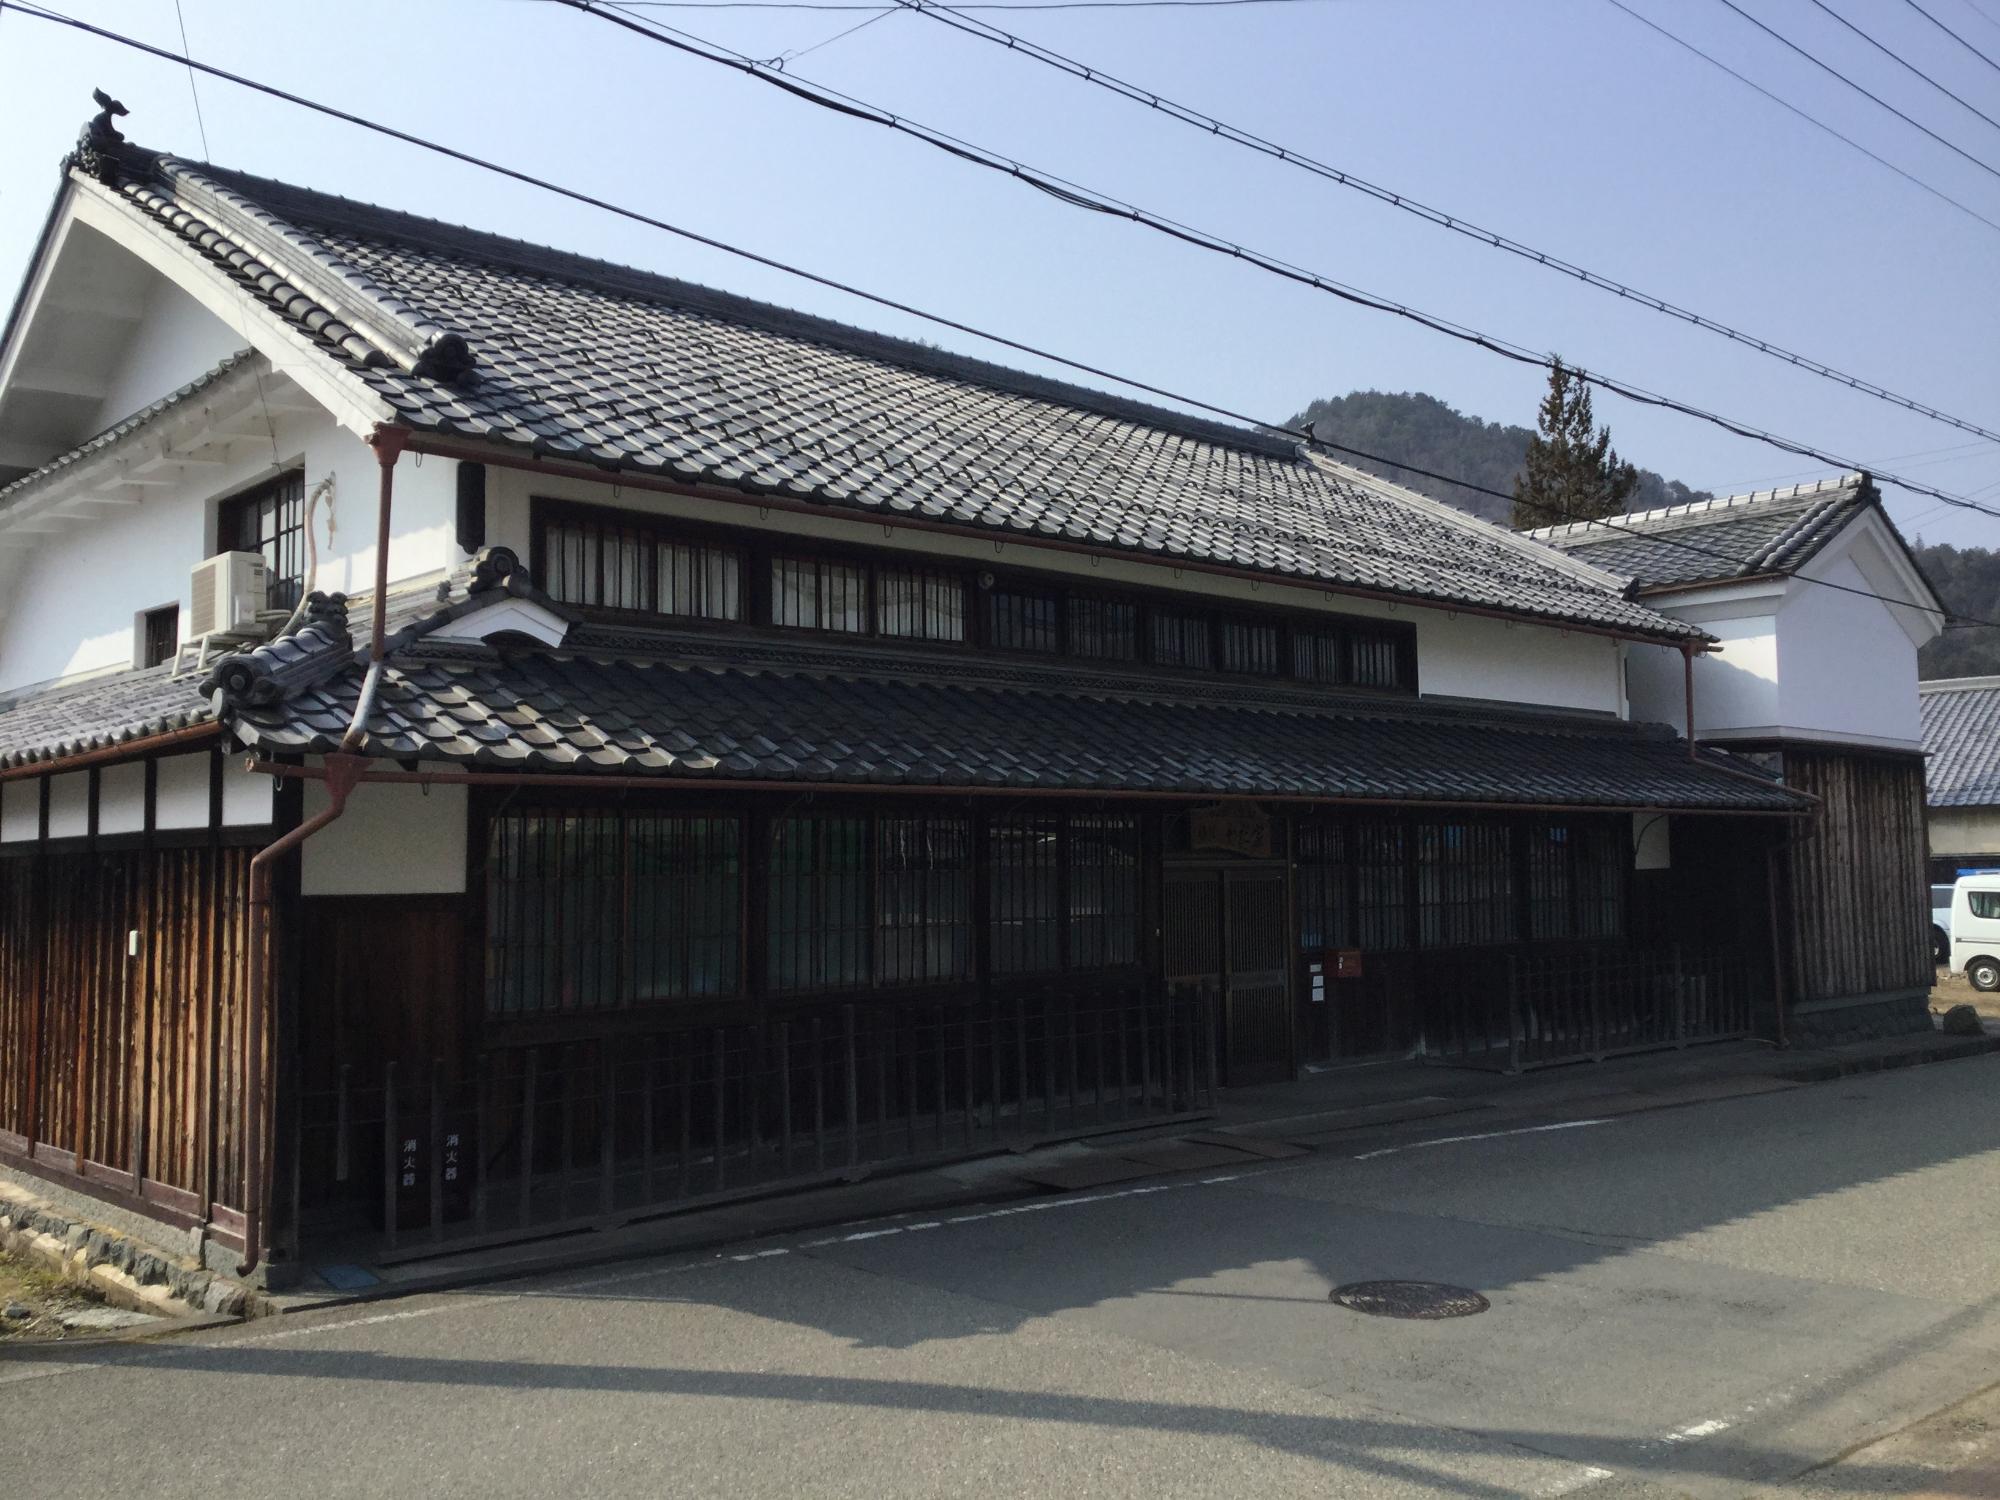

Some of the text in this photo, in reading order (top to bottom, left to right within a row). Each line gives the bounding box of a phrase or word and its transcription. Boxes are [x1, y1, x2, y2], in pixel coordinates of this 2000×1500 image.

[403, 1139, 416, 1186] 消火器
[445, 1134, 458, 1180] 消火器
